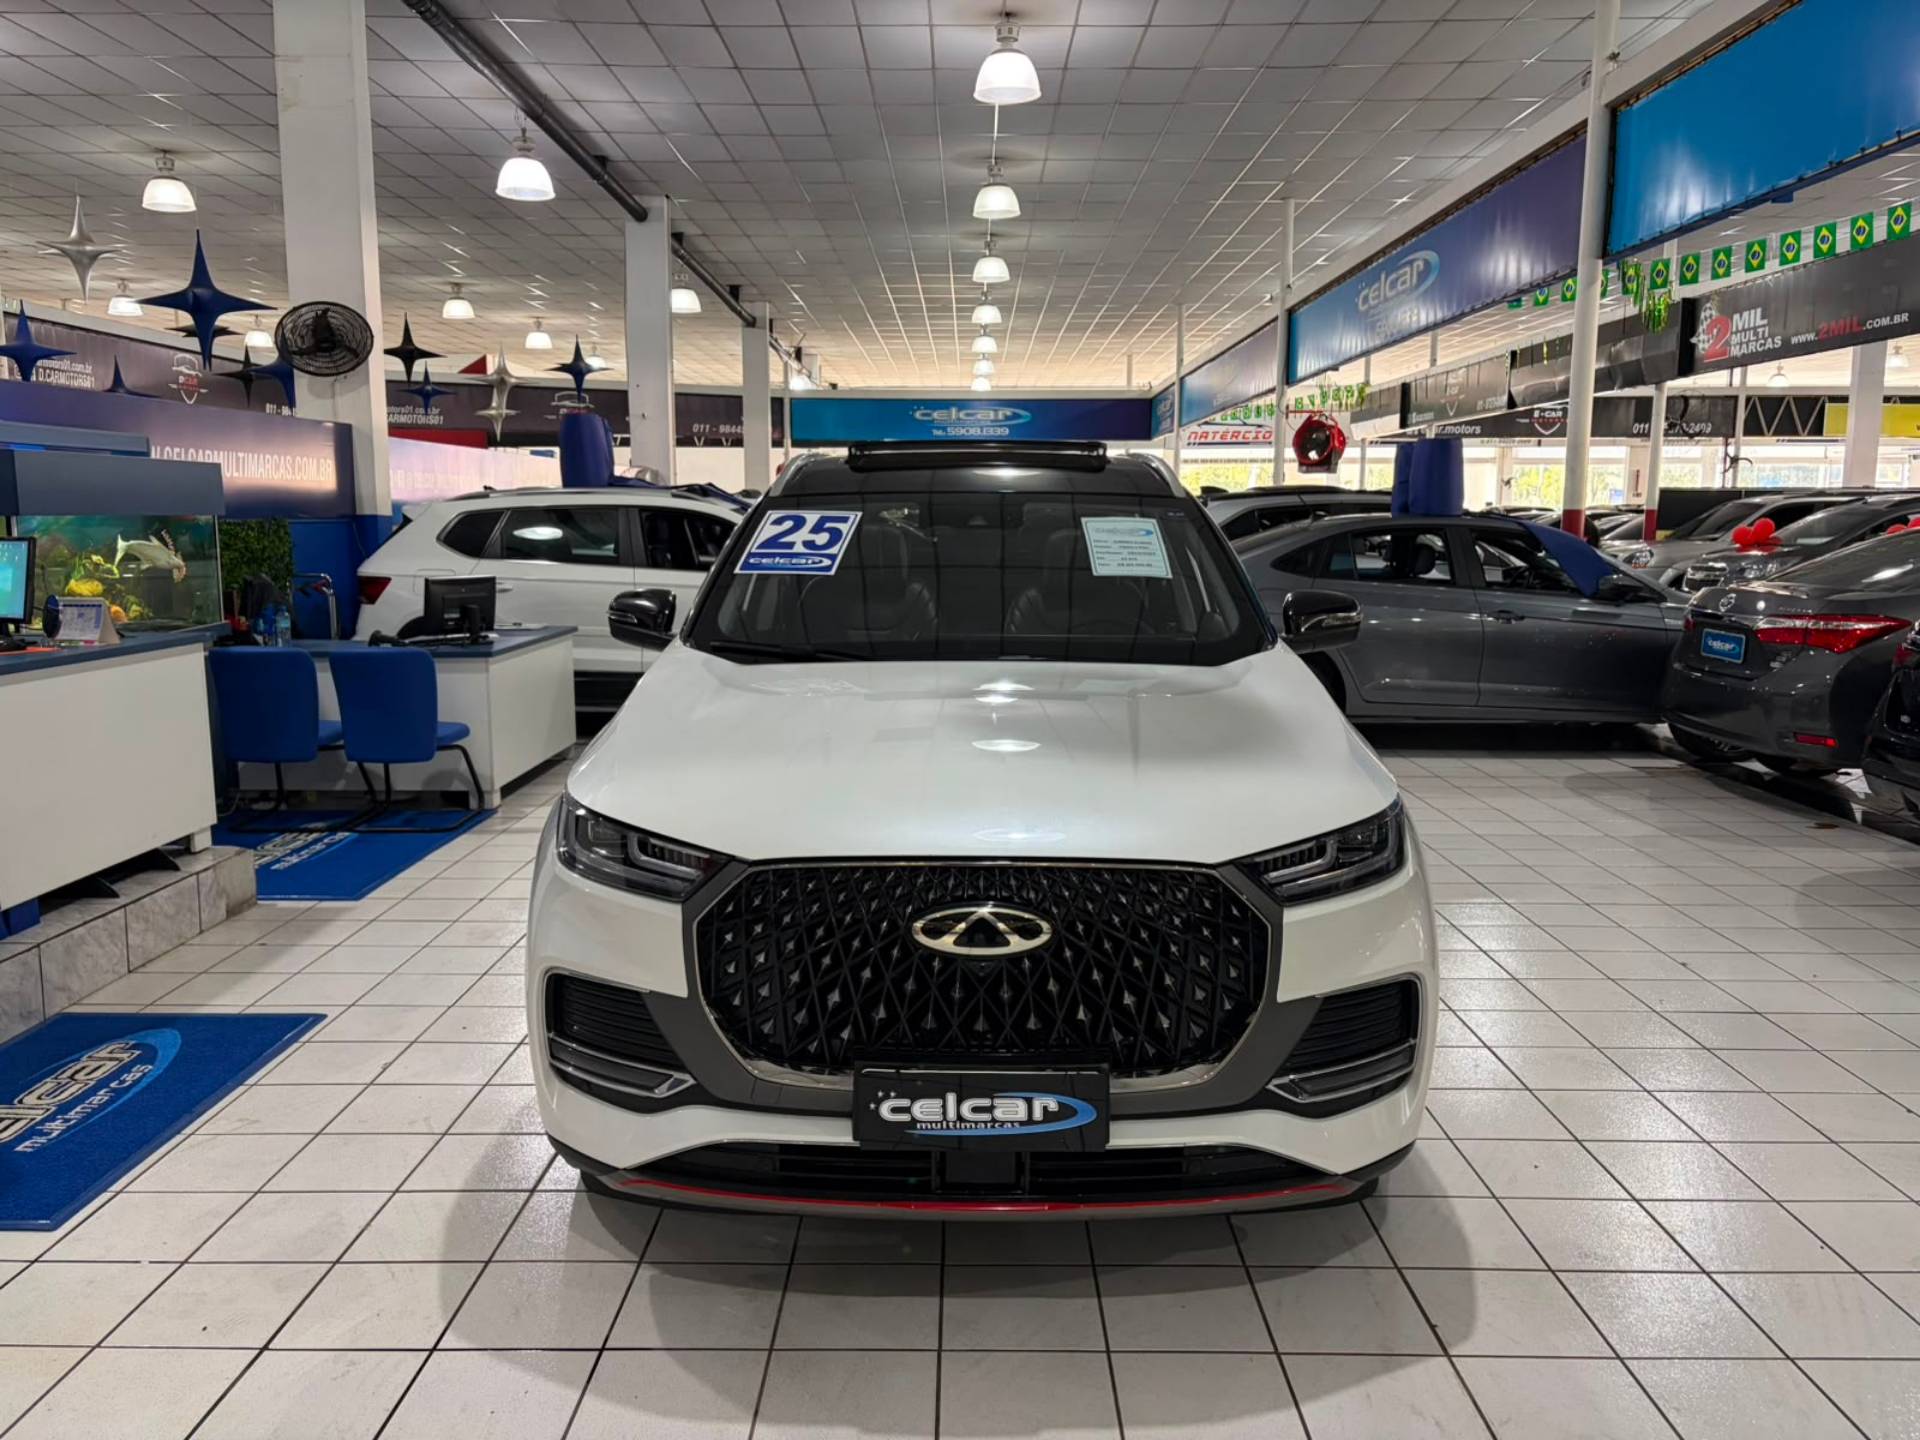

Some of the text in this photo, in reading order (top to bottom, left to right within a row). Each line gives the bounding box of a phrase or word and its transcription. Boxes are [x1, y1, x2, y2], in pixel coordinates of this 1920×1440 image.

[1358, 260, 1425, 311] celcar
[1704, 307, 1768, 362] 2 MIL
[1731, 336, 1782, 357] MARCAS
[1732, 326, 1769, 344] MULTI
[912, 407, 1013, 421] celcar
[754, 514, 851, 551] 25
[878, 1092, 1060, 1122] celcar
[916, 1121, 1021, 1130] multimarcas
